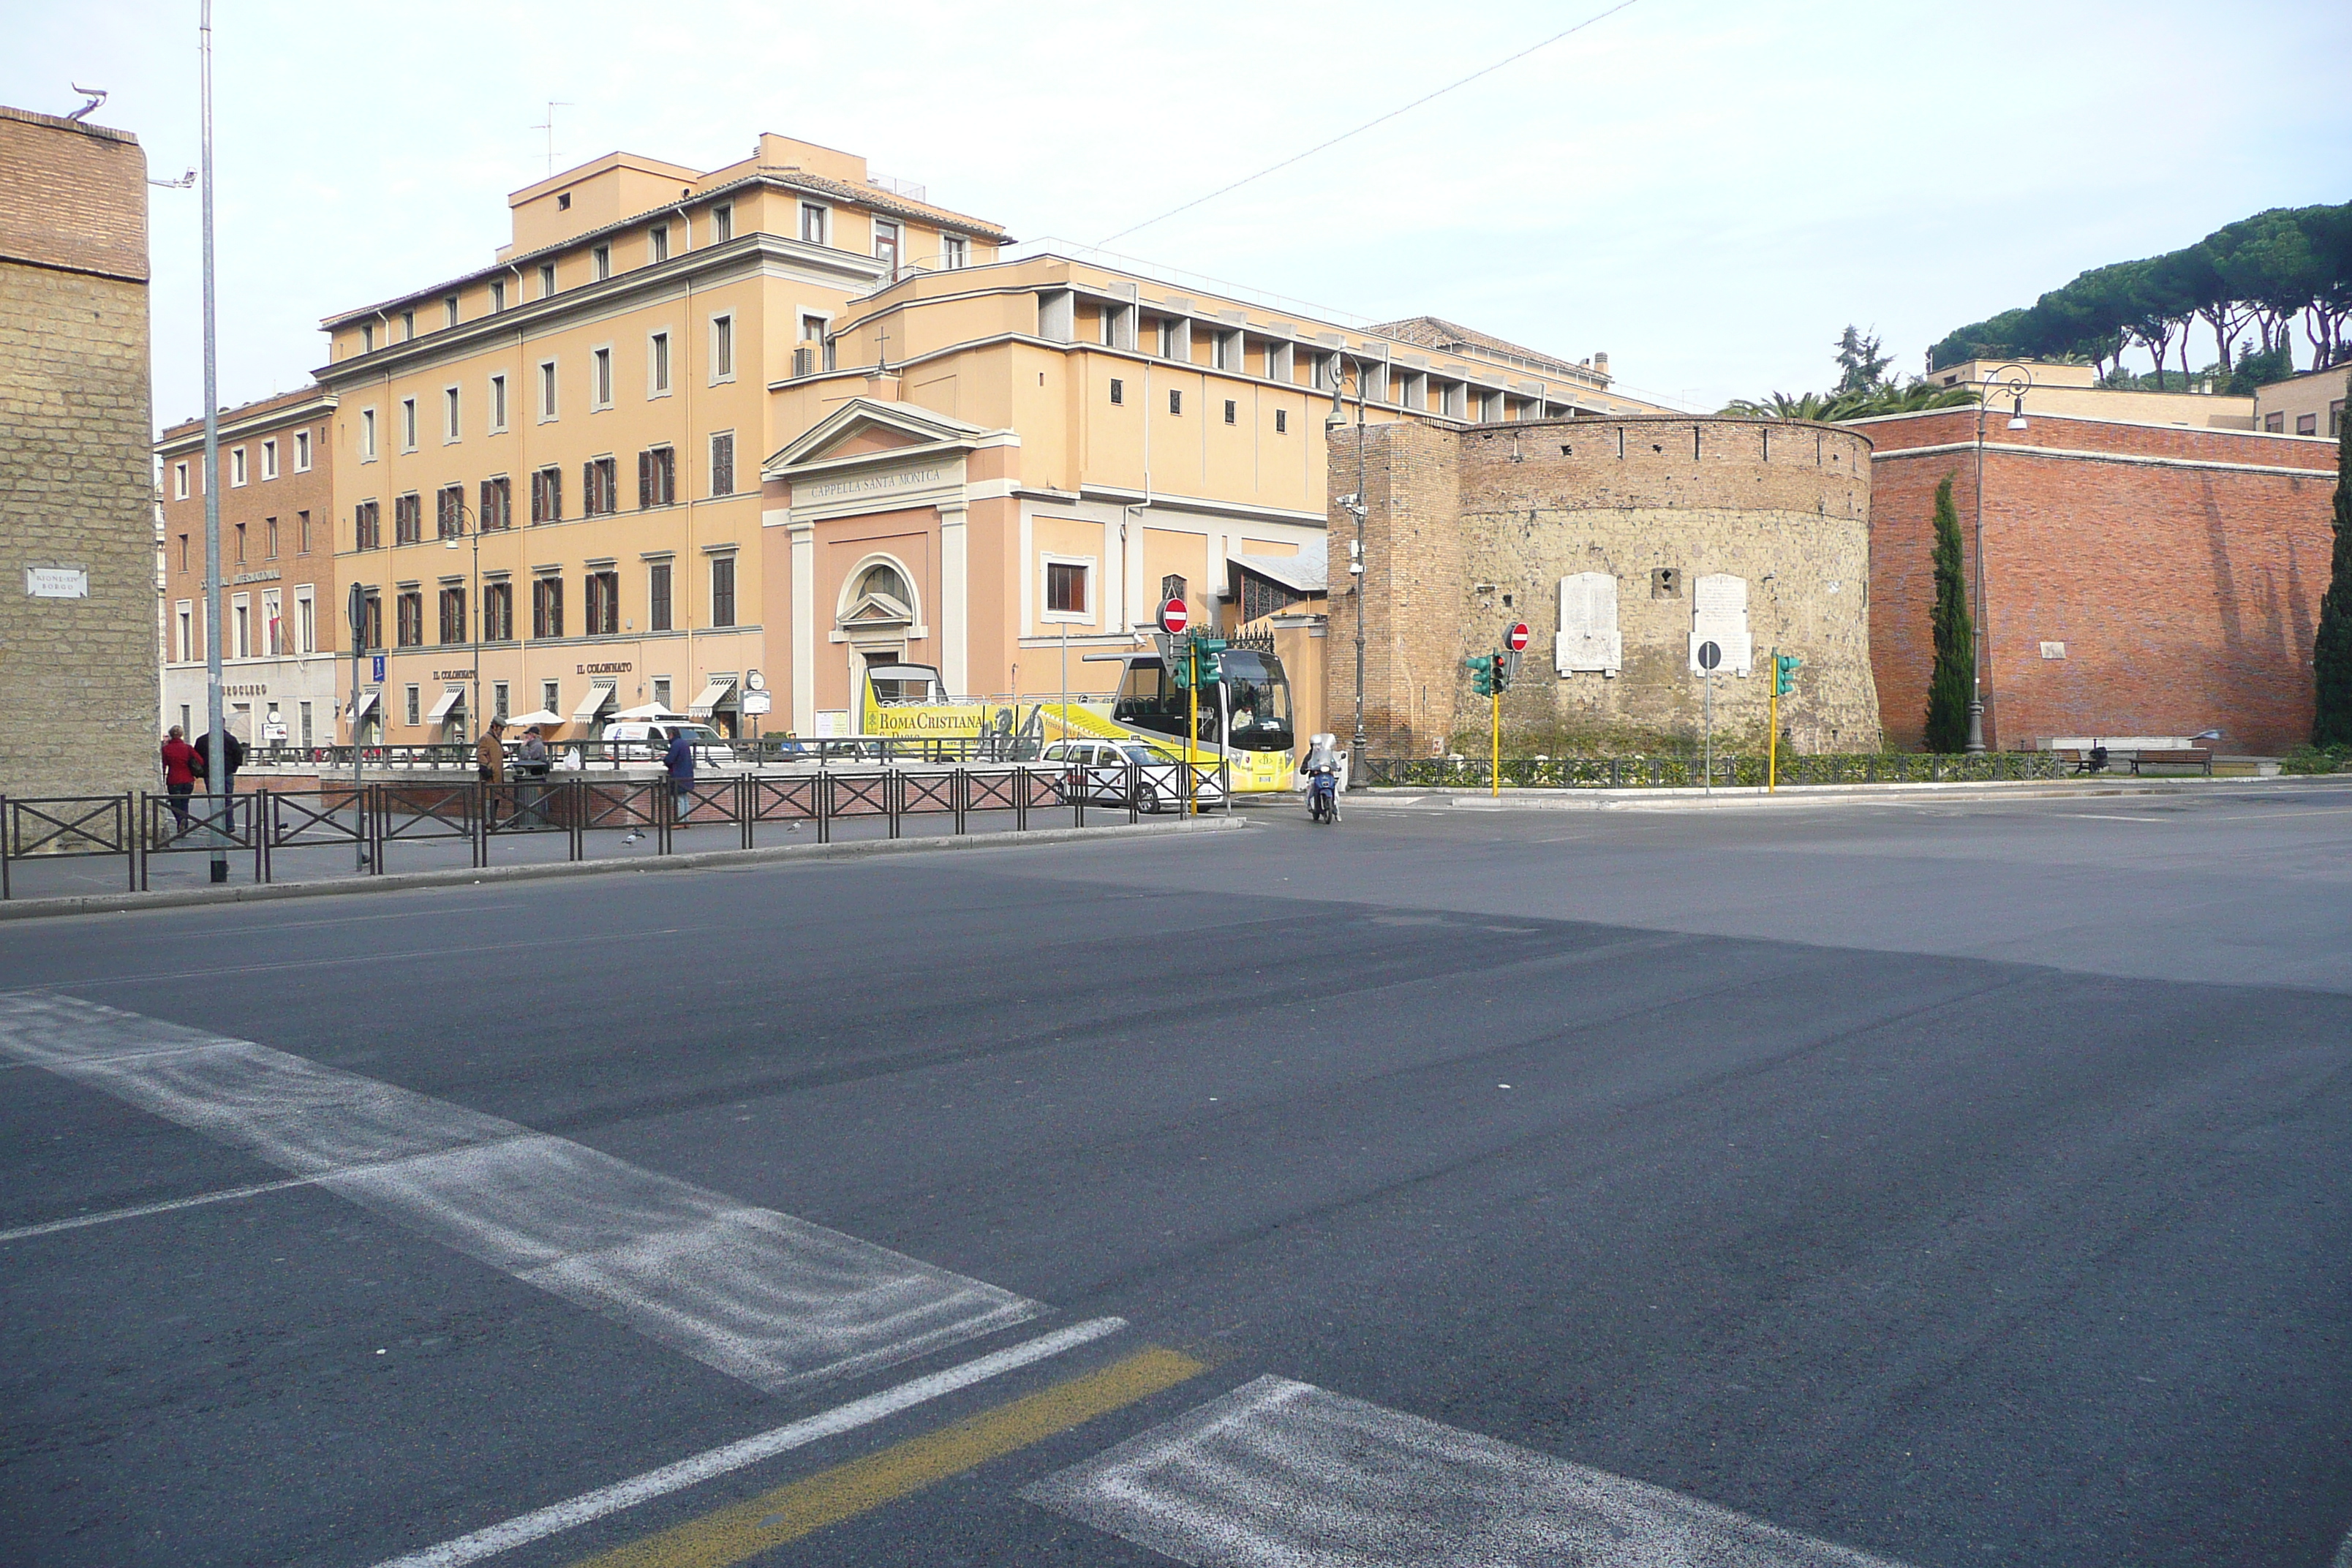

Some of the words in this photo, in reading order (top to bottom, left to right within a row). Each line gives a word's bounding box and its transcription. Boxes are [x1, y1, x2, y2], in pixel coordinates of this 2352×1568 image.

[811, 480, 861, 498] CAPPELLA
[864, 476, 895, 491] SANTA
[899, 469, 941, 486] MONICA
[576, 664, 585, 674] IL
[587, 662, 632, 674] COLONNATO
[433, 671, 440, 680] IL
[441, 669, 475, 680] COLONNAT
